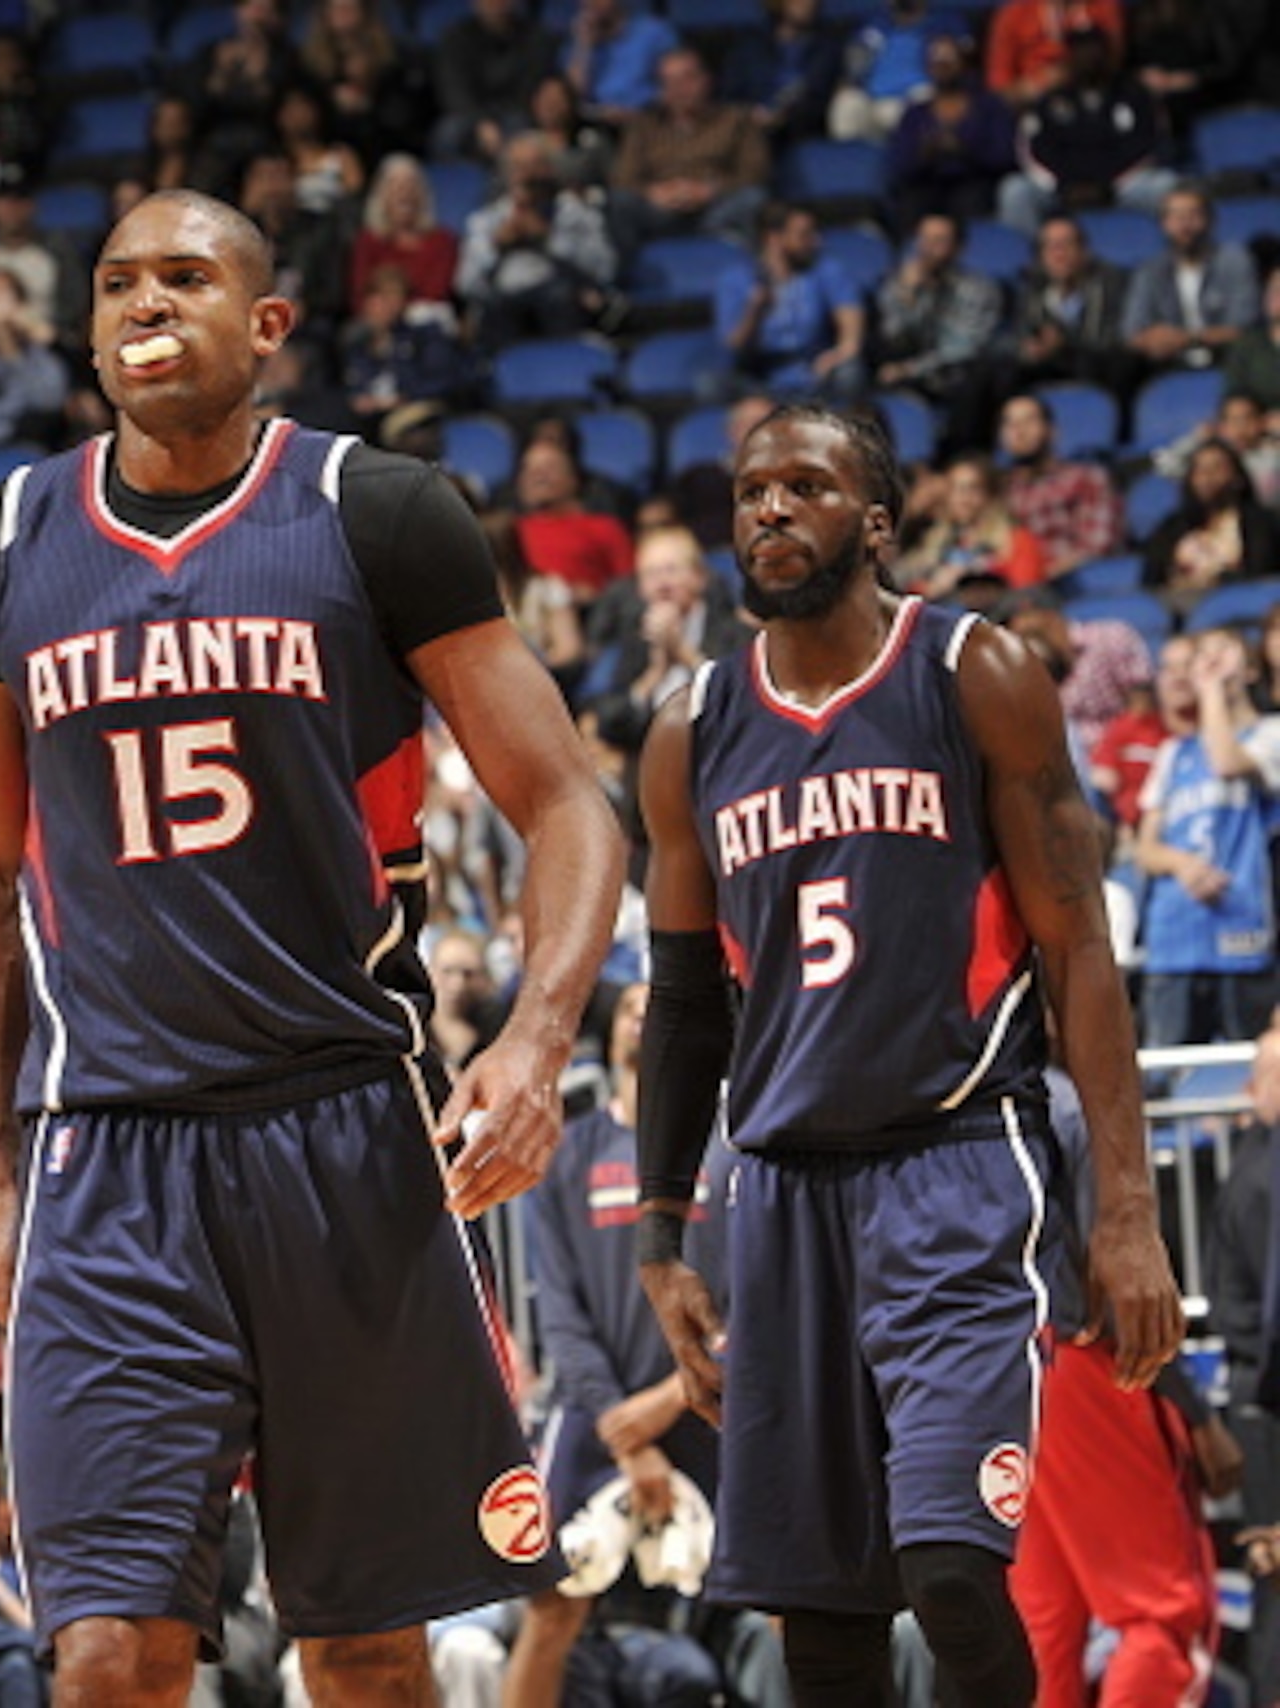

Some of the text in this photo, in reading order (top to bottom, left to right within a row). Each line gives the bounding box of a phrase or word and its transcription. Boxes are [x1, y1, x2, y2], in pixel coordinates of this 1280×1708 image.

[25, 616, 329, 732] ATLANTA
[101, 716, 254, 866] 15
[715, 767, 952, 877] ATLANTA
[795, 876, 857, 990] 5
